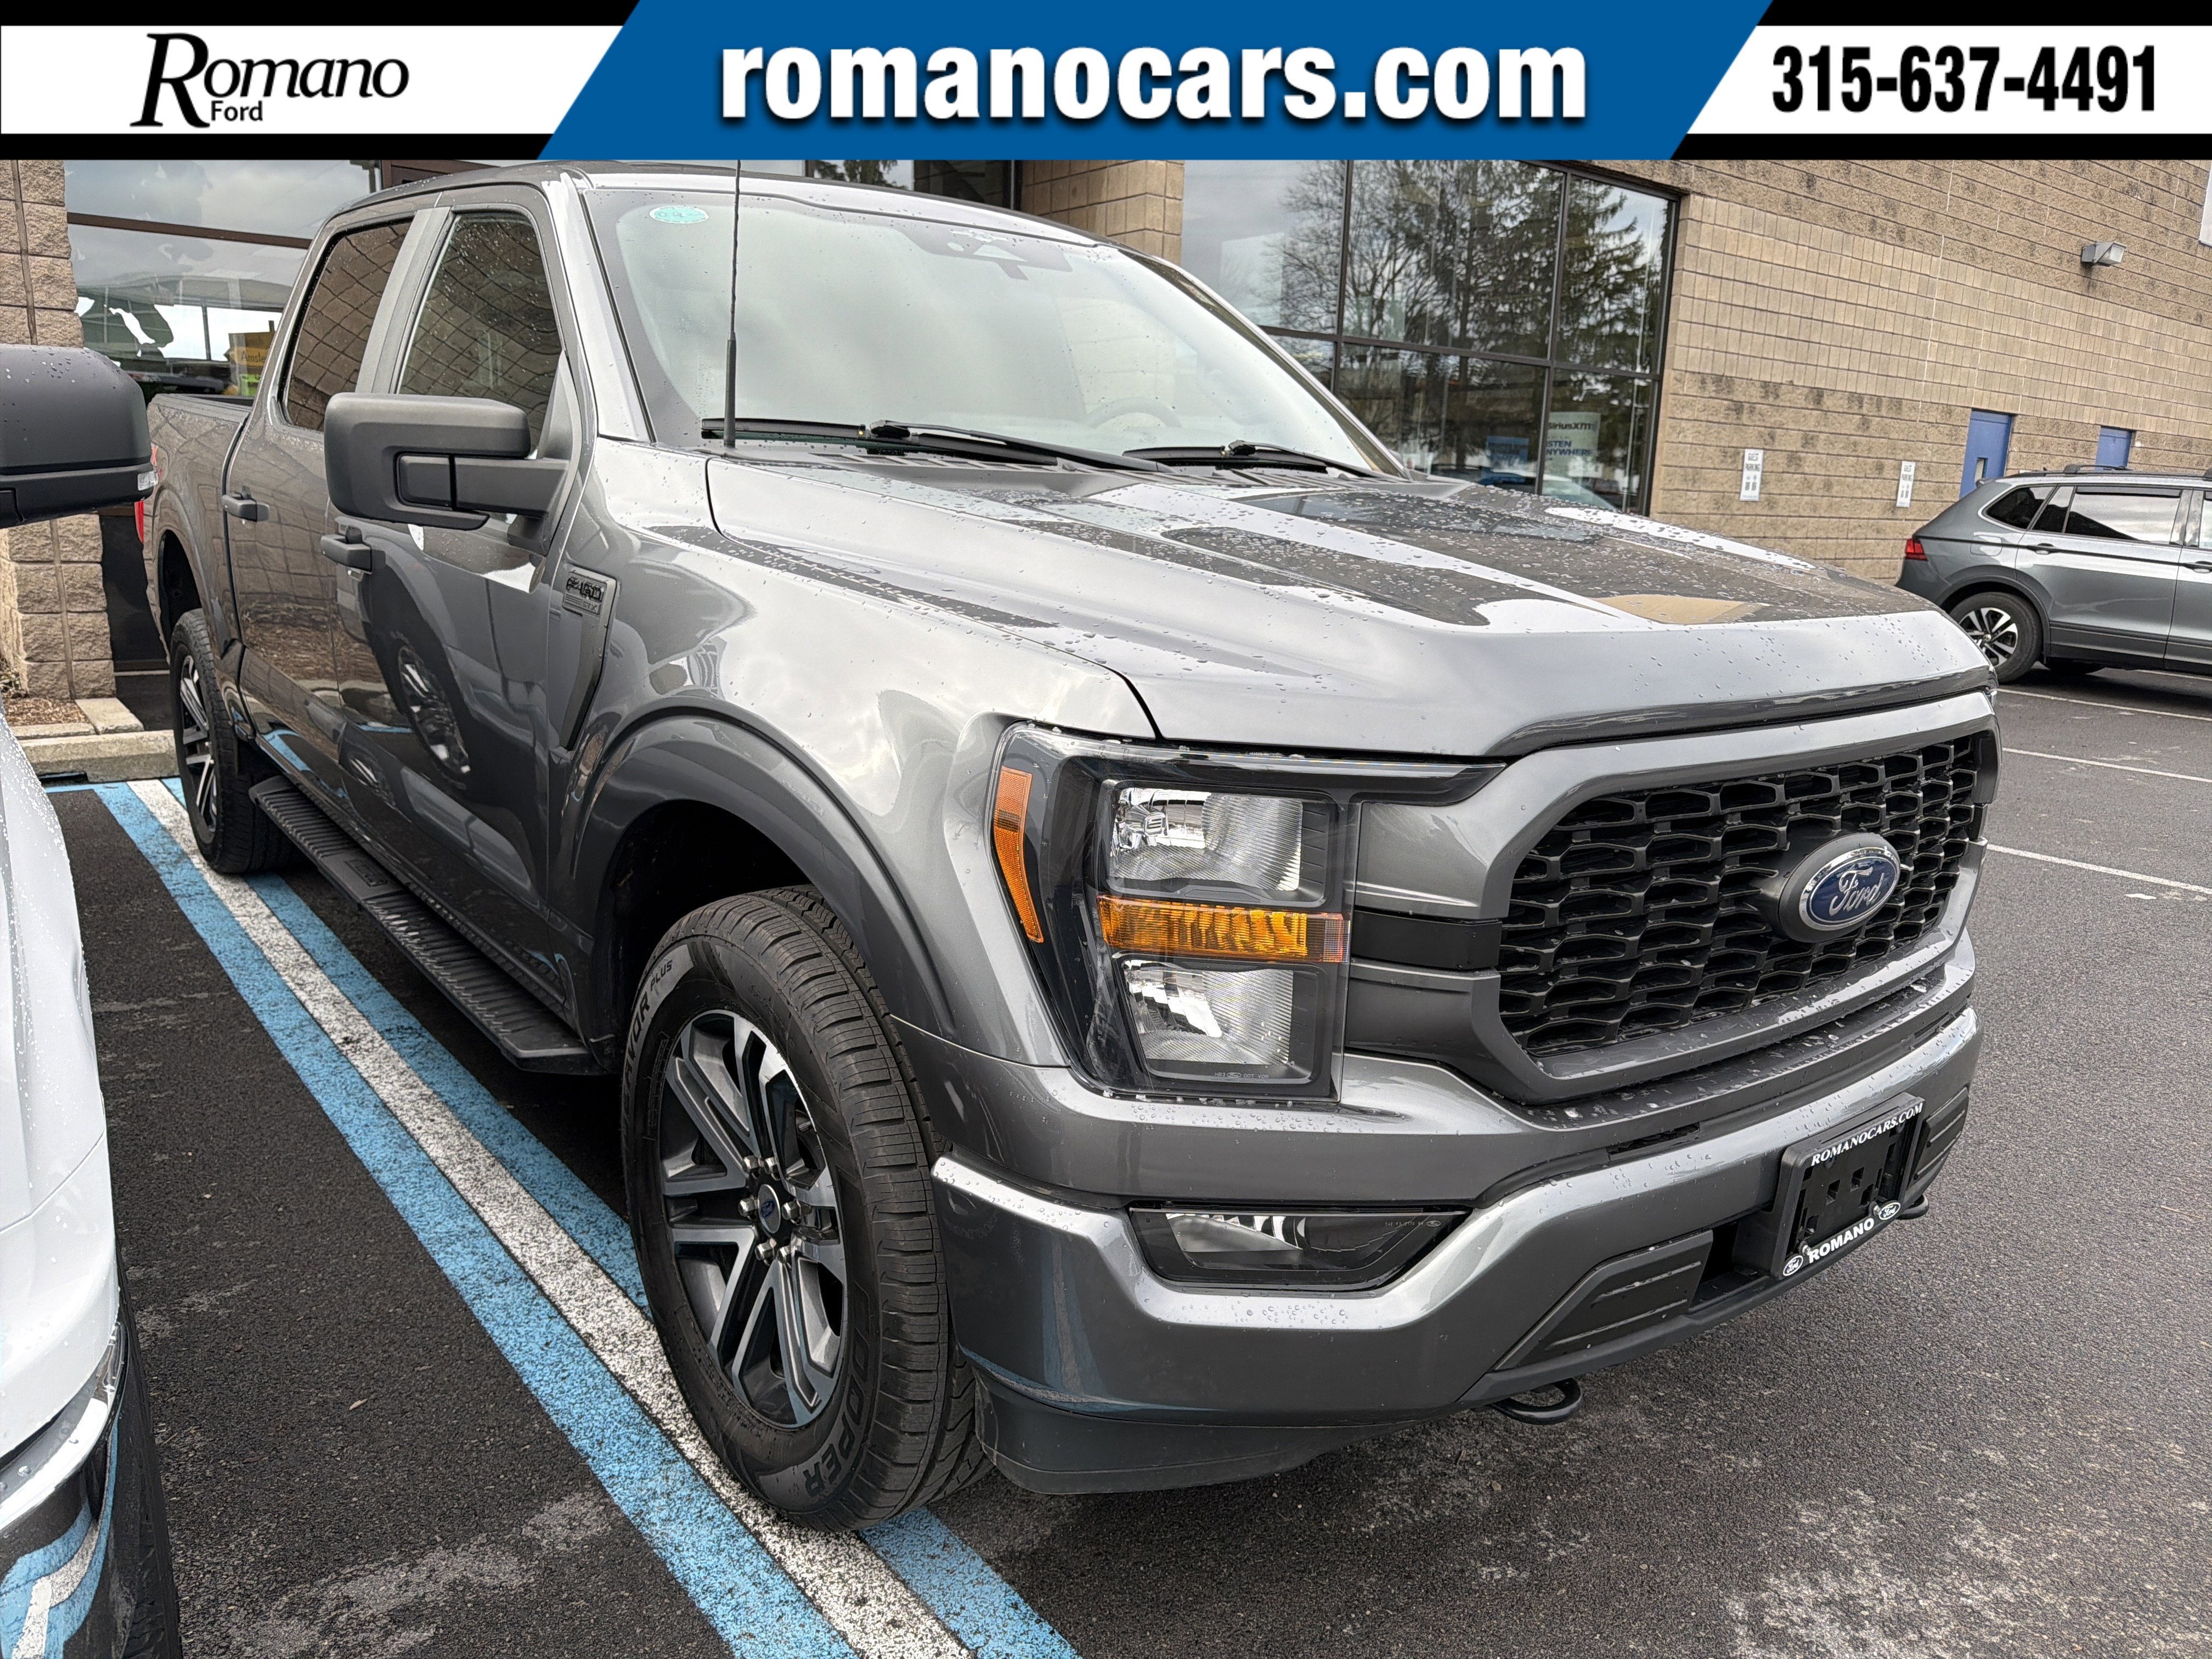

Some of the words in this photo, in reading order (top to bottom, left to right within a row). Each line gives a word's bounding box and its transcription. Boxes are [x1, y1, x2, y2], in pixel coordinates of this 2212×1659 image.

[566, 576, 603, 602] F-150
[1829, 866, 1885, 916] Ford
[650, 960, 673, 991] PLUS
[1811, 1103, 1923, 1166] ROMANOCARS.COM
[1808, 1217, 1875, 1263] ROMANO
